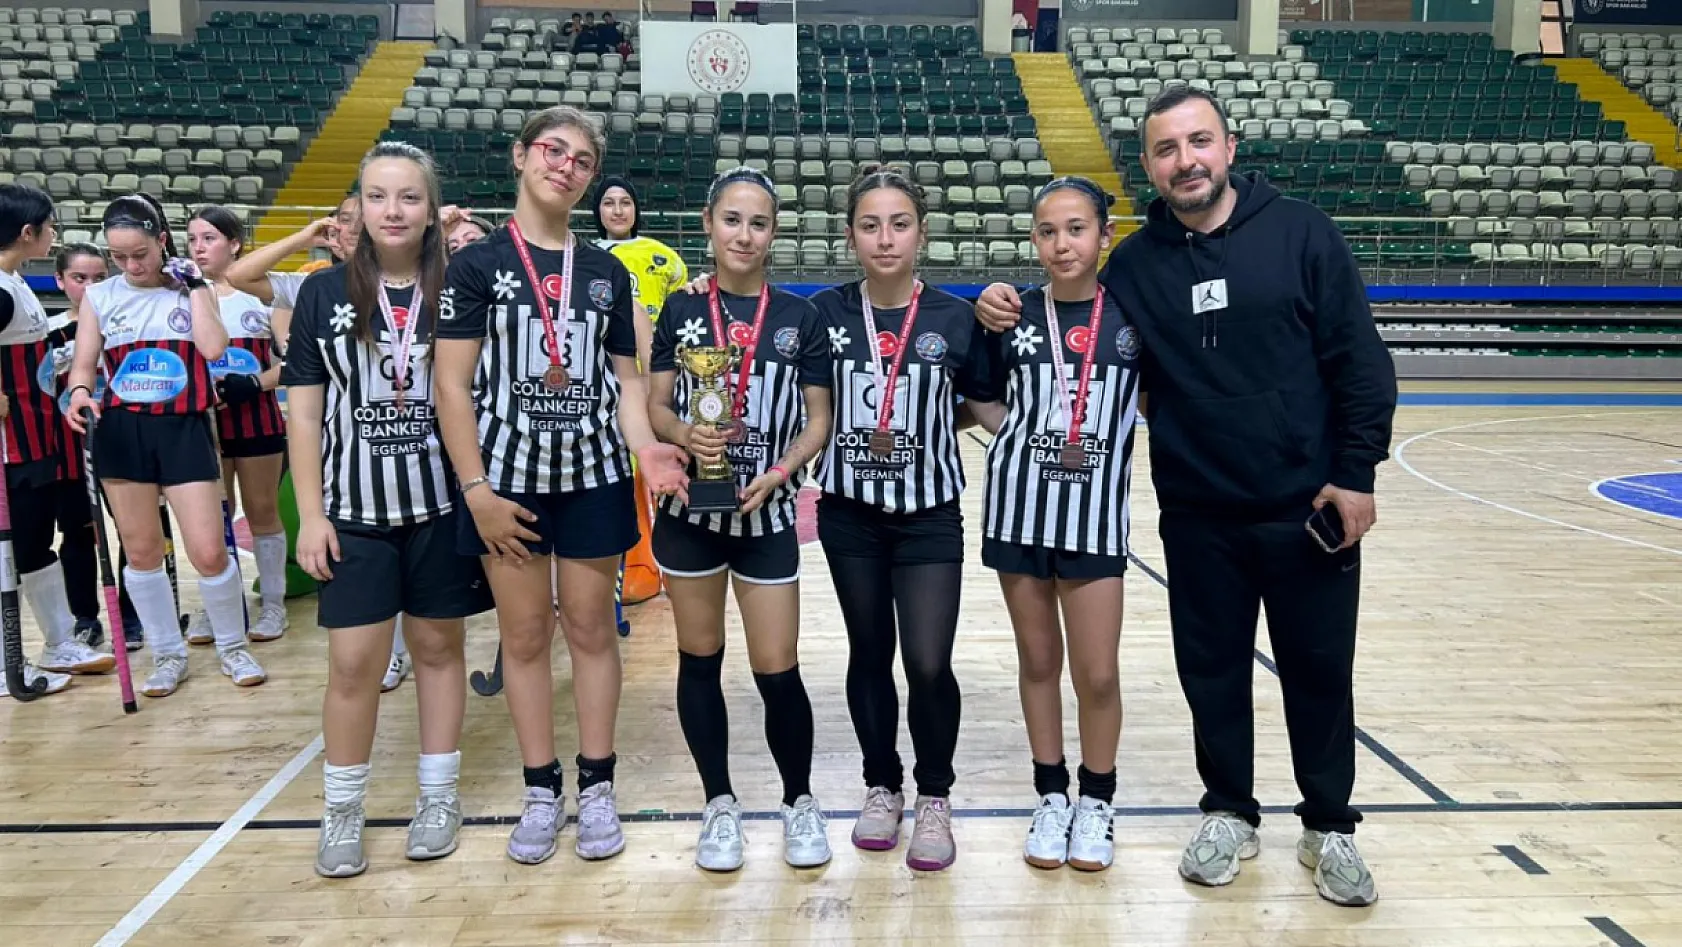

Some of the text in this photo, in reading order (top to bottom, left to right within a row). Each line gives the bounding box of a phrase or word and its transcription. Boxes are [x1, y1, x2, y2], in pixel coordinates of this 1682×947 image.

[121, 377, 174, 393] Madran
[354, 406, 435, 421] COLDWEL
[521, 398, 588, 414] BANKER
[531, 420, 581, 431] EGEMEN
[836, 433, 924, 449] COLELL
[1028, 434, 1110, 454] COLELL
[372, 442, 428, 456] EGEMEN
[723, 444, 762, 459] NKER
[1035, 449, 1099, 467] BAER
[854, 469, 904, 480] EGEMEN
[1042, 469, 1090, 482] EGEMEN
